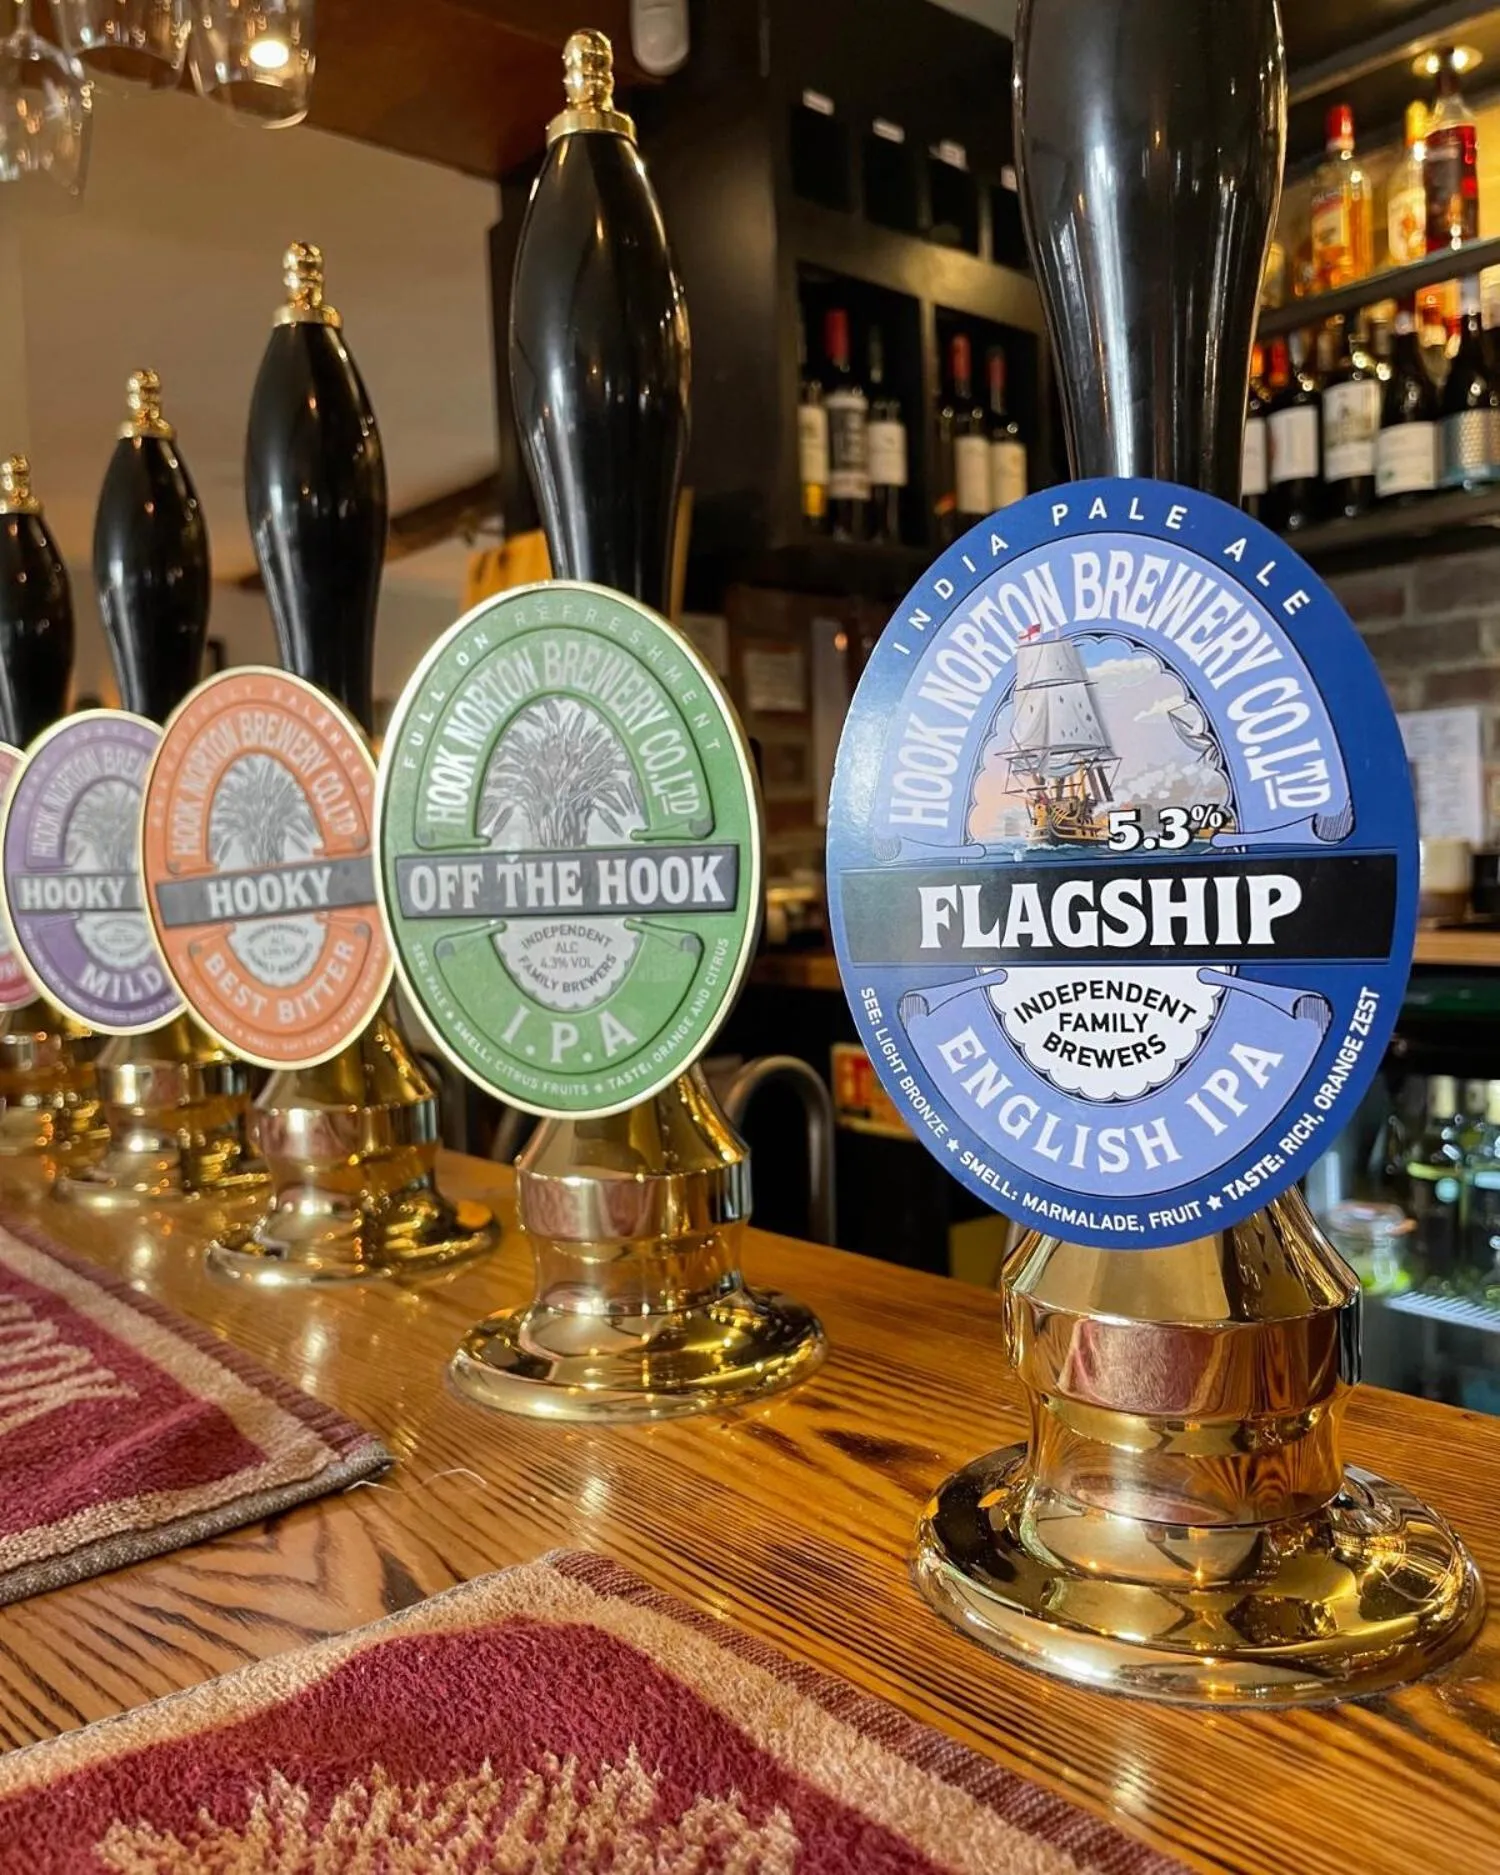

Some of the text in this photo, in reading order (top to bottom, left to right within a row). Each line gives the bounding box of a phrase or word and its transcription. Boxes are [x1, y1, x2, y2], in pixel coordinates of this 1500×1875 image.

[892, 498, 1311, 656] INDIA PALE ALE
[917, 561, 1068, 728] NORTON
[1071, 549, 1285, 691] BREWERY
[403, 605, 721, 770] FULL ON REFRESHMENT
[443, 647, 540, 754] NORTON
[543, 640, 671, 736] BREWERY
[239, 710, 330, 777] BREWERY
[889, 712, 964, 828] HOOK
[426, 743, 478, 825] HOOK
[1108, 803, 1224, 853] 5.3%
[19, 877, 126, 909] HOOKY
[208, 867, 332, 918] HOOKY
[409, 855, 726, 912] OFF THE HOOK
[917, 874, 1303, 949] FLAGSHIP
[520, 924, 613, 949] INDEPENDENT
[555, 942, 579, 953] ALC
[570, 957, 594, 968] VOL
[79, 962, 165, 1003] MILD
[204, 952, 268, 1017] BEST
[277, 940, 355, 1024] BITTER
[518, 954, 617, 993] FAMILY BREWERS
[1013, 980, 1197, 1025] INDEPENDENT
[426, 976, 449, 1010] PALE
[495, 1060, 539, 1089] CITRUS
[543, 1080, 588, 1095] FRUITS
[653, 1016, 694, 1063] ORANGE
[690, 990, 711, 1016] AND
[705, 937, 730, 987] CITRUS
[1043, 1031, 1166, 1068] BREWERS
[1058, 1012, 1149, 1033] FAMILY
[861, 986, 1381, 1234] SEE: LIGHT BRONZE SMELL: MARMALADE, FRUIT TASTE: RICH, ORANGE ZEST
[937, 1025, 1284, 1174] ENGLISH IPA
